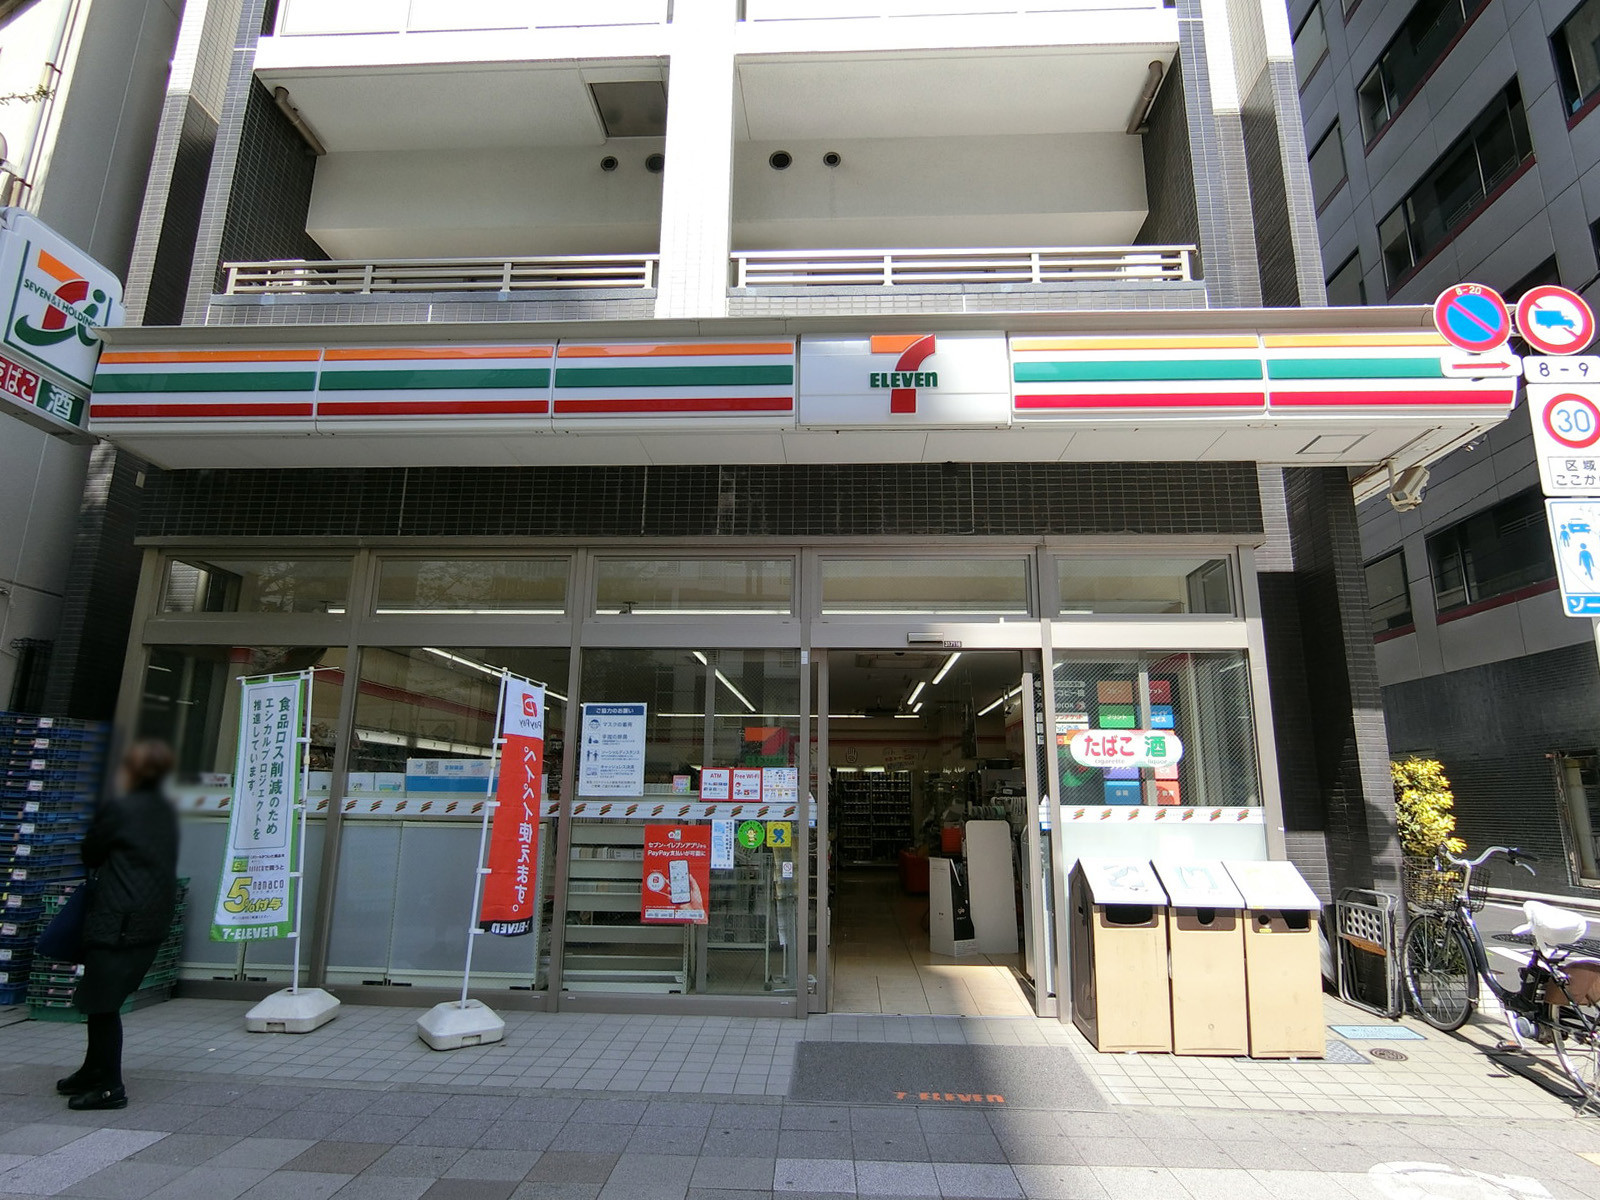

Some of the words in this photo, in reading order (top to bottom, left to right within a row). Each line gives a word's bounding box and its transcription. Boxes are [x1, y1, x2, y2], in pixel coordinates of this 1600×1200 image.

[1455, 285, 1482, 296] 8-20
[61, 302, 103, 328] HOLDIN
[869, 334, 937, 413] 7
[46, 385, 76, 420] 酒
[1557, 409, 1590, 433] 30
[1565, 459, 1597, 472] 区域
[1556, 474, 1600, 486] ここか
[1084, 735, 1135, 757] たばこ
[1145, 736, 1167, 757] 酒
[253, 697, 275, 841] エシカルプロジェクトを
[266, 696, 291, 835] 食品ロス削減のため
[252, 880, 284, 891] nanaco
